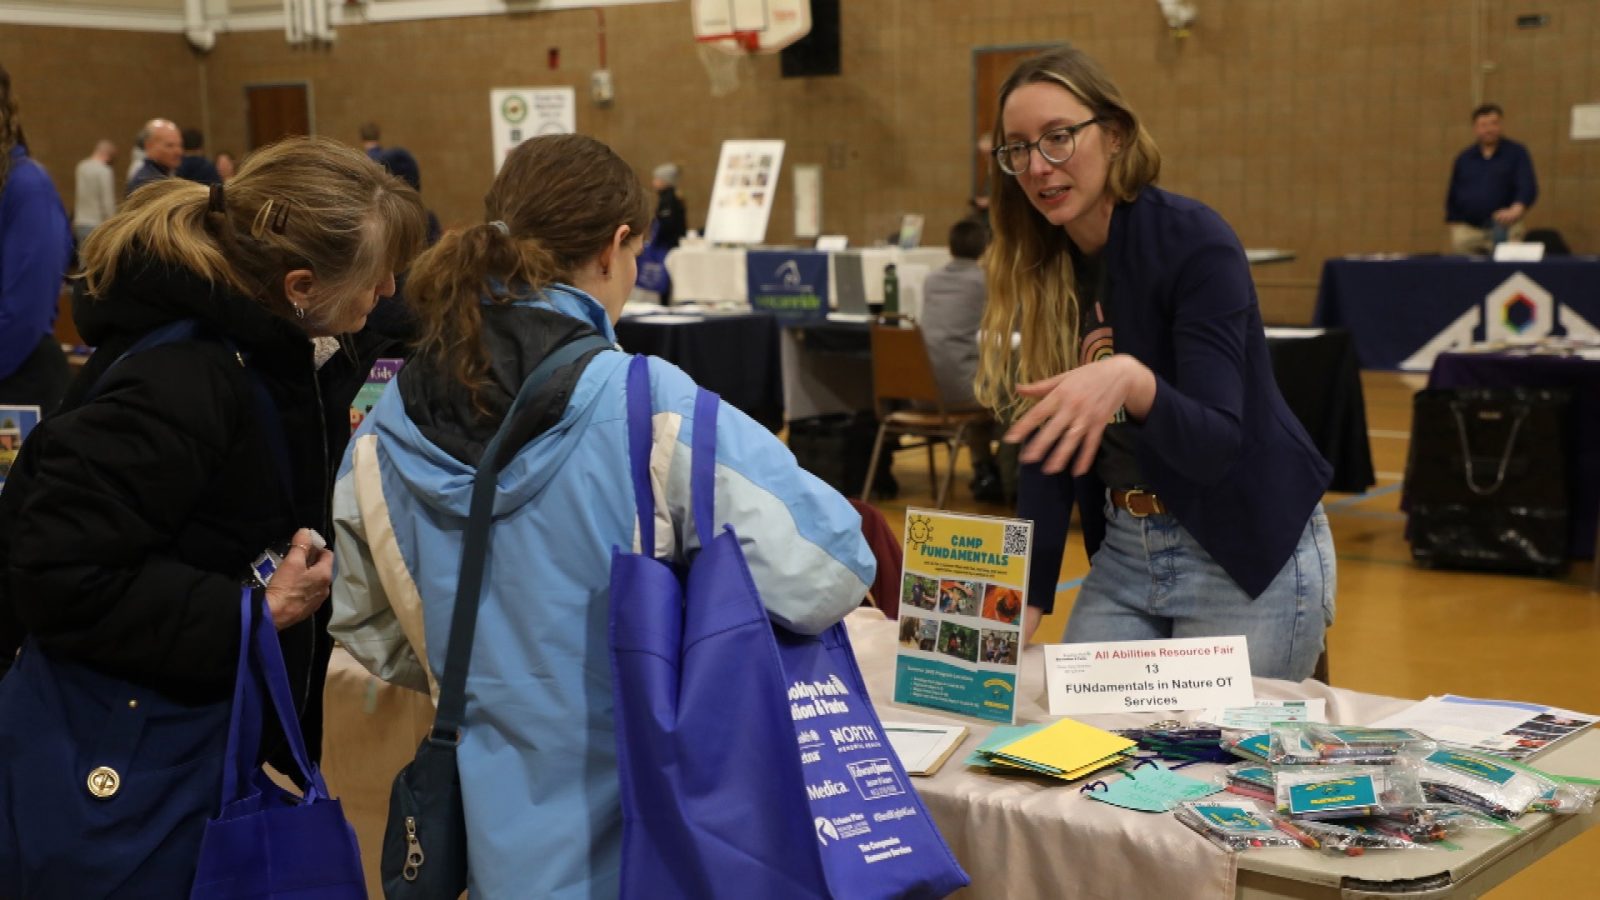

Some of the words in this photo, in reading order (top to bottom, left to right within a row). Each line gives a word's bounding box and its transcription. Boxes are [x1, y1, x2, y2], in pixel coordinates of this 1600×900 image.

[370, 366, 392, 380] Kids
[951, 534, 983, 549] CAMP
[920, 544, 1009, 566] FUNDAMENTALS
[1094, 650, 1109, 660] All
[1111, 649, 1156, 660] Abilities
[1159, 647, 1211, 658] Resource
[1213, 645, 1234, 655] Fair
[1144, 664, 1160, 674] 13
[813, 681, 840, 696] Park
[1065, 680, 1154, 694] FUNdamentals
[1157, 680, 1169, 690] in
[1172, 678, 1213, 690] Nature
[1216, 677, 1233, 687] OT
[820, 698, 849, 714] Parks
[1124, 695, 1178, 707] Services
[830, 725, 878, 746] NORTH
[806, 779, 850, 801] Medica
